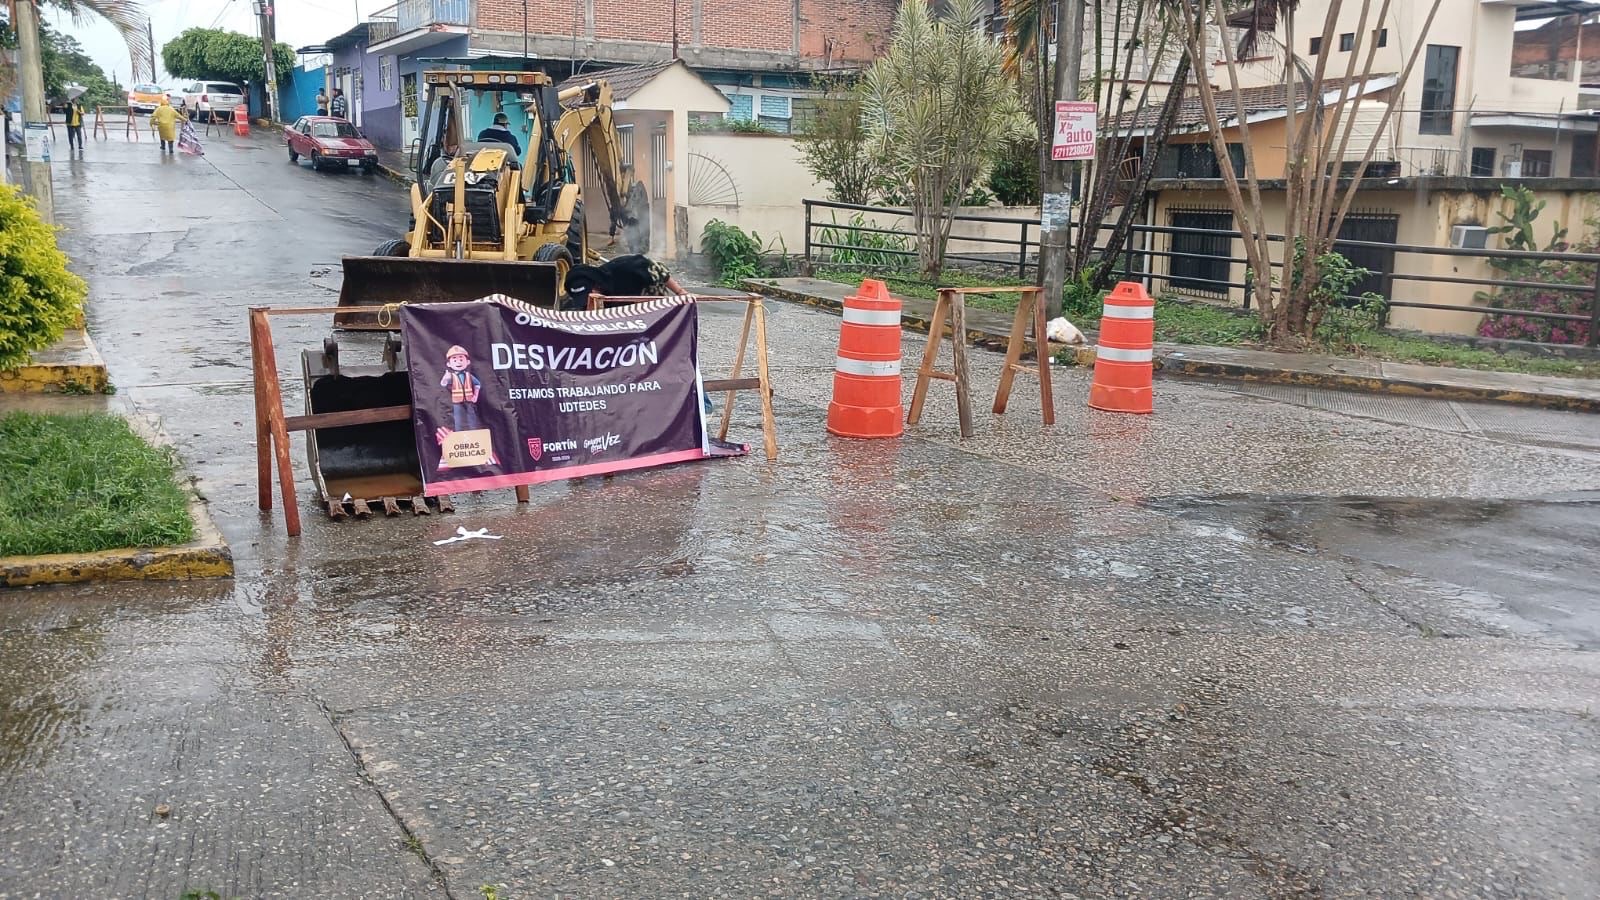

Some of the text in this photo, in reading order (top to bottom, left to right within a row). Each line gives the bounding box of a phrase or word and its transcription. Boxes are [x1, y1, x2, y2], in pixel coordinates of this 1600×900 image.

[1066, 128, 1092, 143] auto
[508, 380, 661, 400] ESTAMOS TRABAJANDO PARA
[559, 399, 607, 413] UDTEDES
[453, 441, 480, 450] OBRAS
[543, 438, 577, 452] FORTÍN
